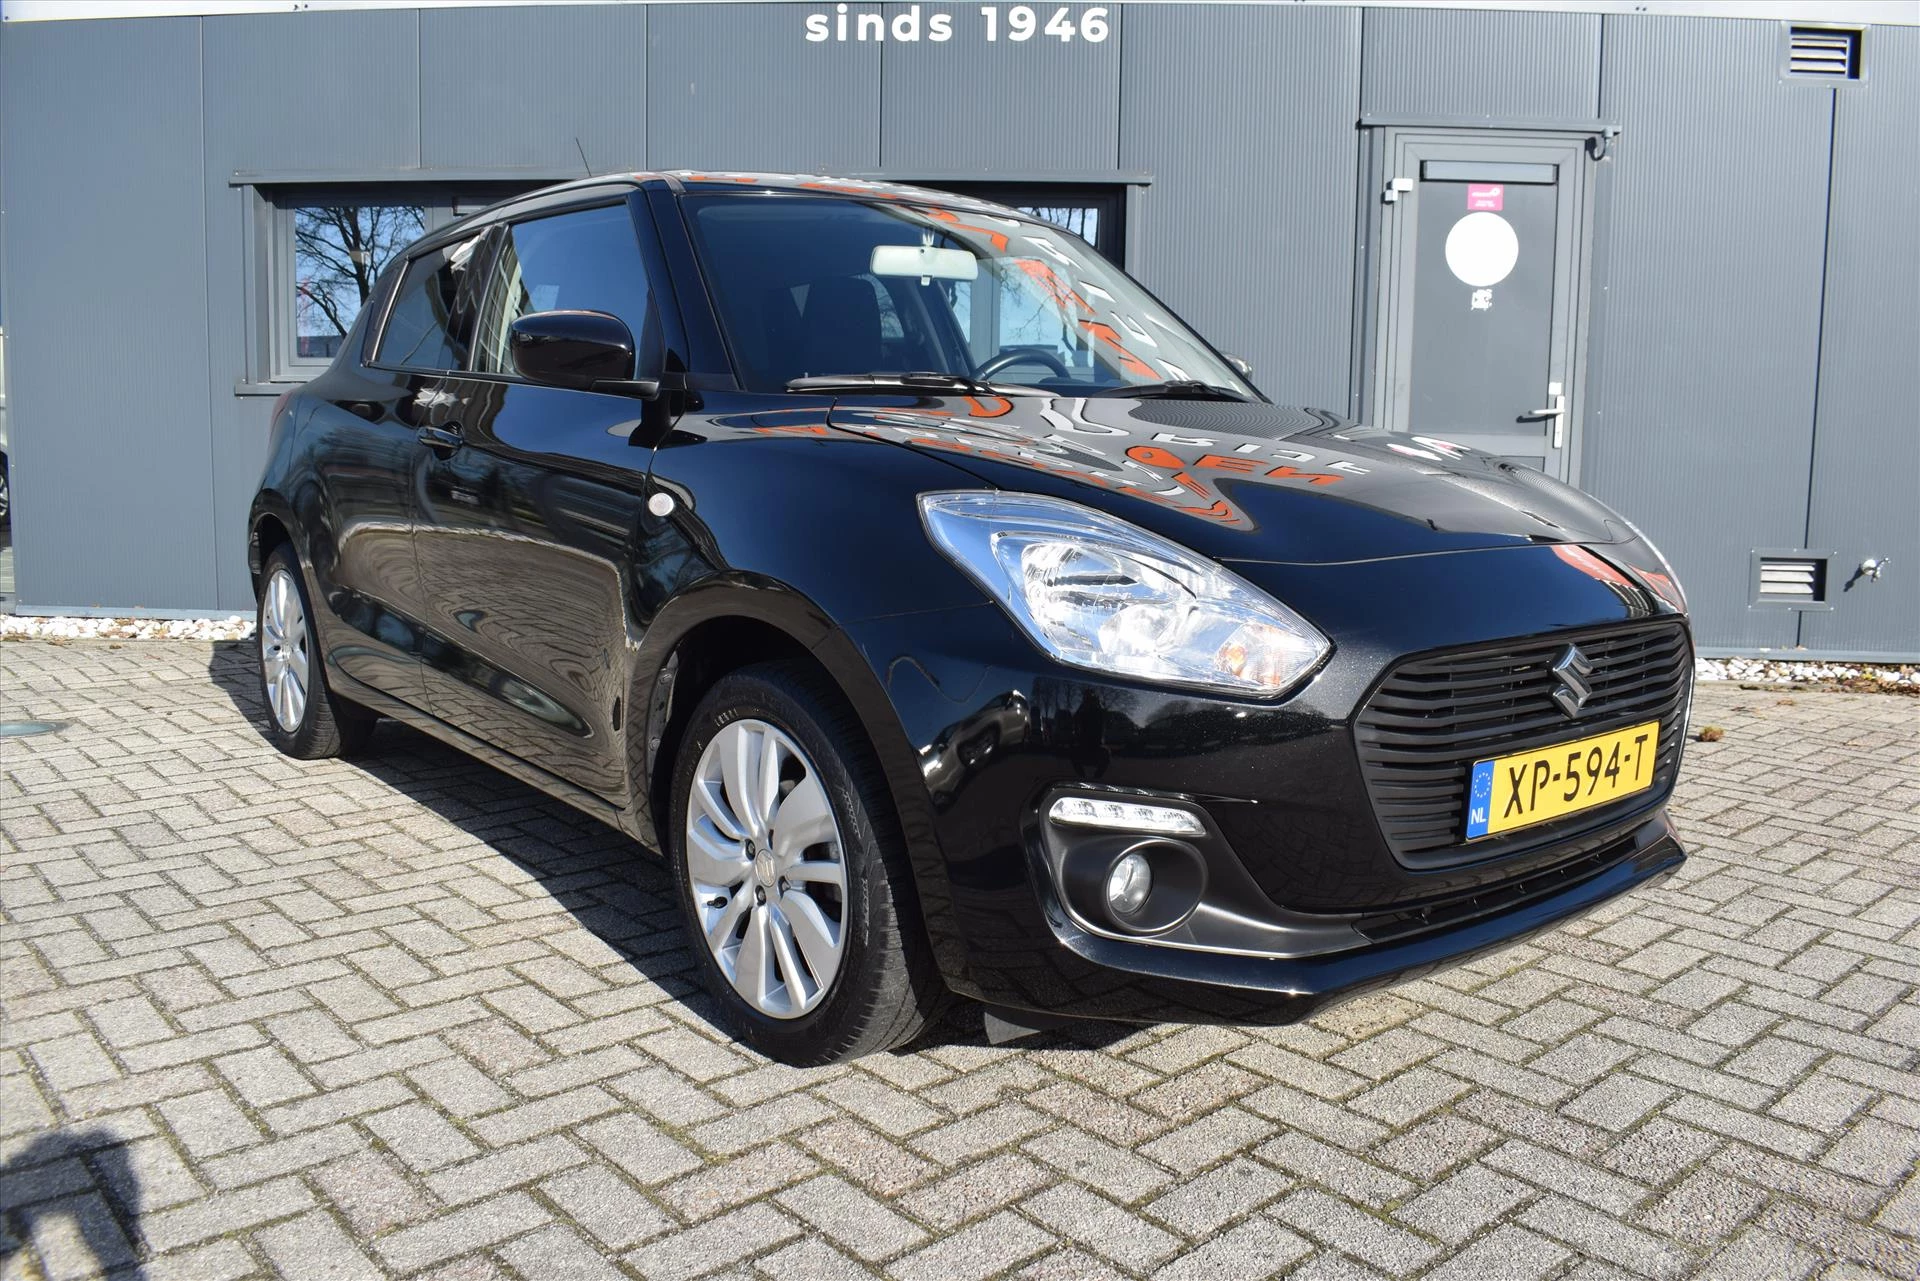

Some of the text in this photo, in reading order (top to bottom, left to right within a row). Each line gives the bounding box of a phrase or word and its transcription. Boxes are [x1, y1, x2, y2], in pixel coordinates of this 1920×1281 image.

[805, 3, 1109, 43] sinds 1946
[1503, 733, 1649, 819] XP-594-T
[1470, 807, 1487, 825] NL
